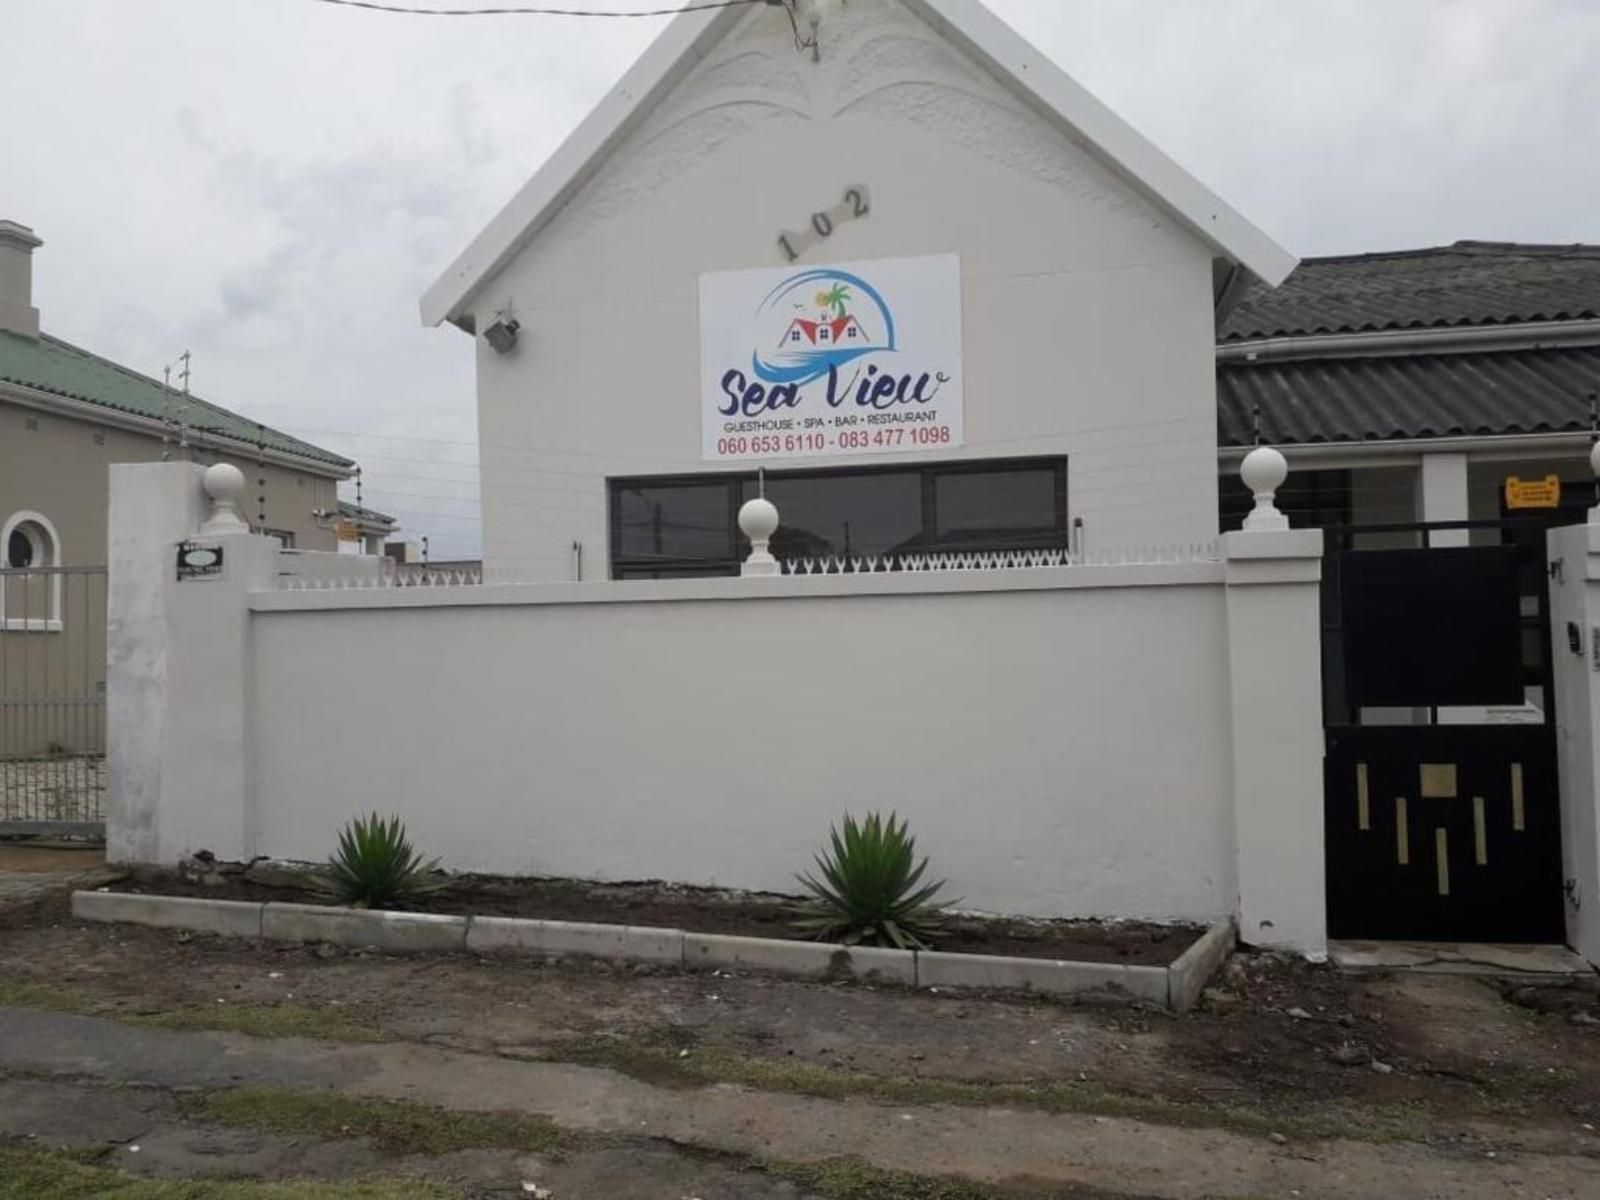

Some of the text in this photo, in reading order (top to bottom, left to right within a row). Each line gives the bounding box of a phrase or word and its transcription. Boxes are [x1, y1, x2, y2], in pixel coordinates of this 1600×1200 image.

[718, 361, 951, 417] Sea View
[723, 411, 937, 433] GUESTHOUSE SPA BAR RESTAURANT
[718, 437, 747, 455] 060
[751, 435, 780, 453] 653
[785, 433, 824, 451] 6110
[839, 431, 869, 449] 083
[873, 429, 904, 446] 477
[909, 426, 950, 444] 1098
